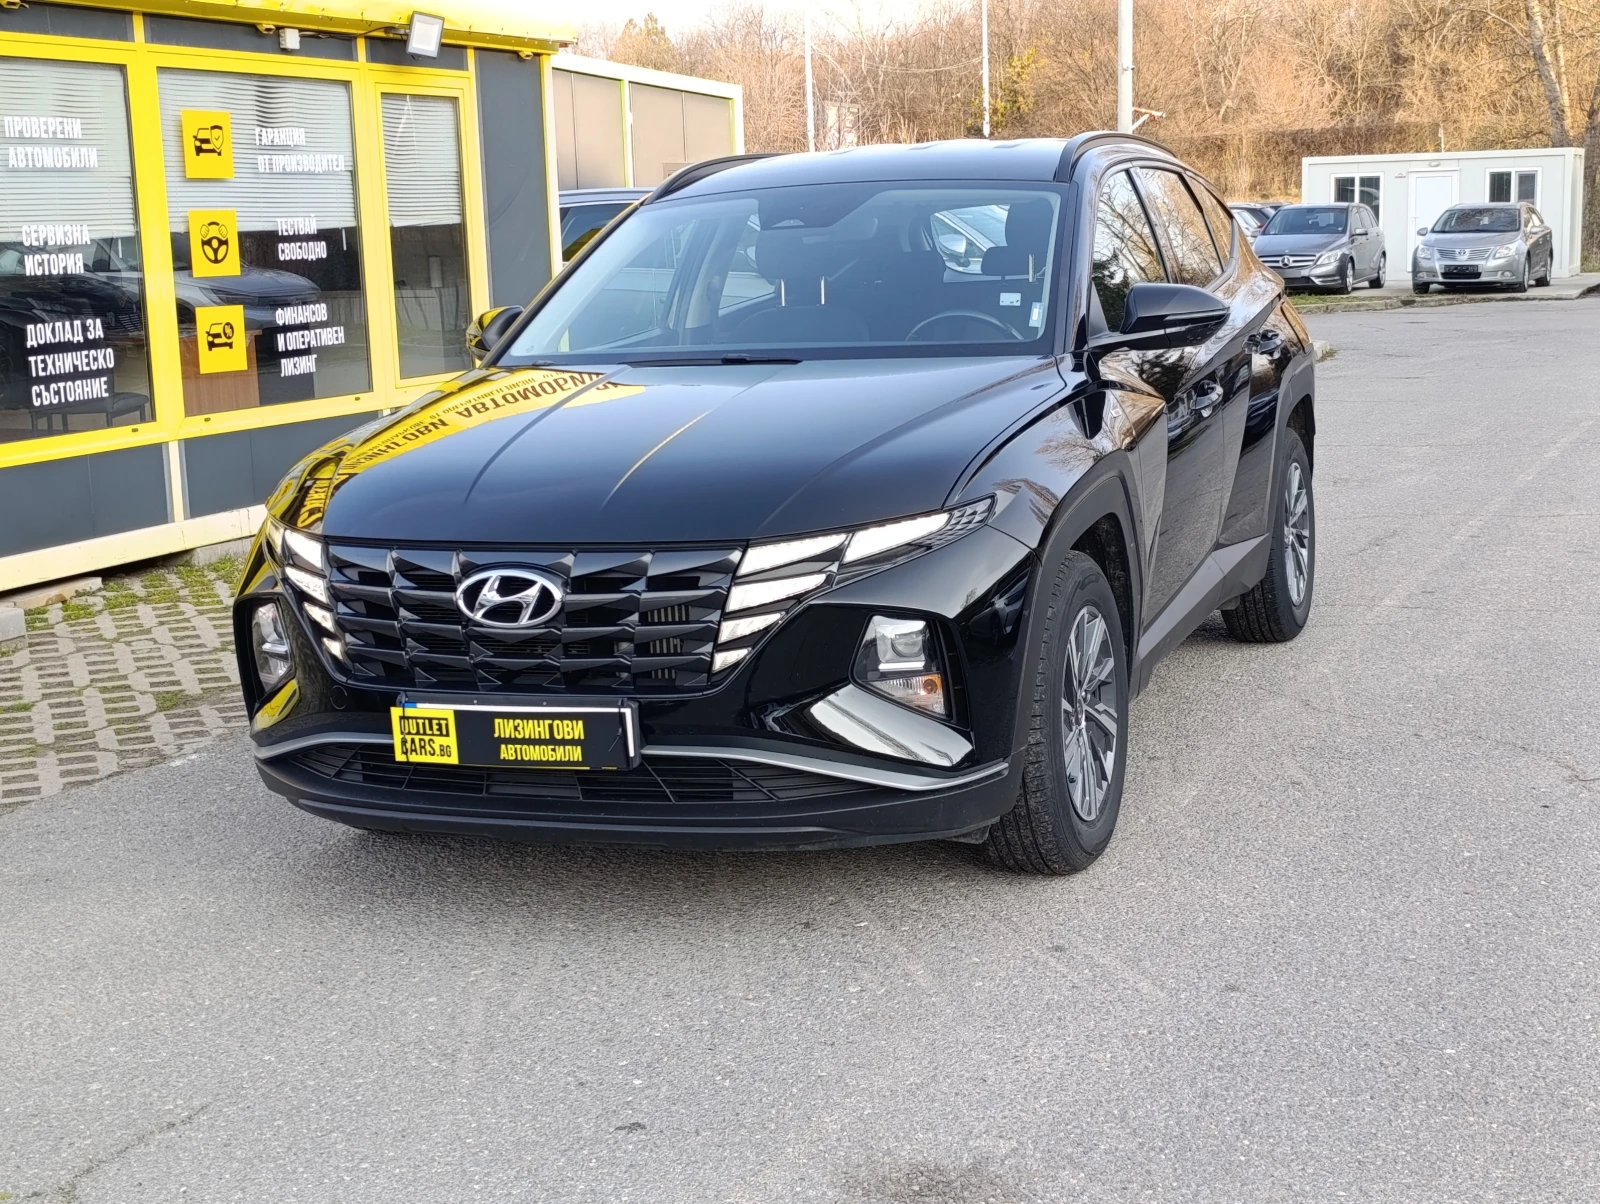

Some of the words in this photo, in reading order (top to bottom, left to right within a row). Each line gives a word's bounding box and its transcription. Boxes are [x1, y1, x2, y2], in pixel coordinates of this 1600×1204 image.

[4, 116, 82, 138] ПРОВЕРЕНИ
[255, 128, 306, 147] ГАРАНЦИЯ
[8, 147, 98, 168] АВТОМОБИЛИ
[258, 155, 270, 172] ОТ
[273, 154, 345, 173] ПРОИЗВОДИТЕЛ
[22, 224, 91, 247] СЕРВИЗНА
[276, 213, 317, 236] ТЕСТВАЙ
[278, 241, 328, 261] СВОБОДНО
[24, 253, 84, 276] ИСТОРИЯ
[275, 303, 328, 326] ФИНАНСОВ
[26, 319, 84, 348] ДОКЛАД
[87, 318, 104, 340] ЗА
[277, 333, 286, 352] И
[286, 326, 345, 351] ОПЕРАТИВЕН
[28, 348, 115, 378] ТЕХНИЧЕСКО
[280, 354, 318, 377] ЛИЗИНГ
[32, 377, 109, 407] СЪСТОЯНИЕ
[401, 718, 448, 736] OUTLET
[494, 718, 584, 740] ЛИЗИНГОВИ
[500, 744, 582, 762] АВТОМОБИЛИ
